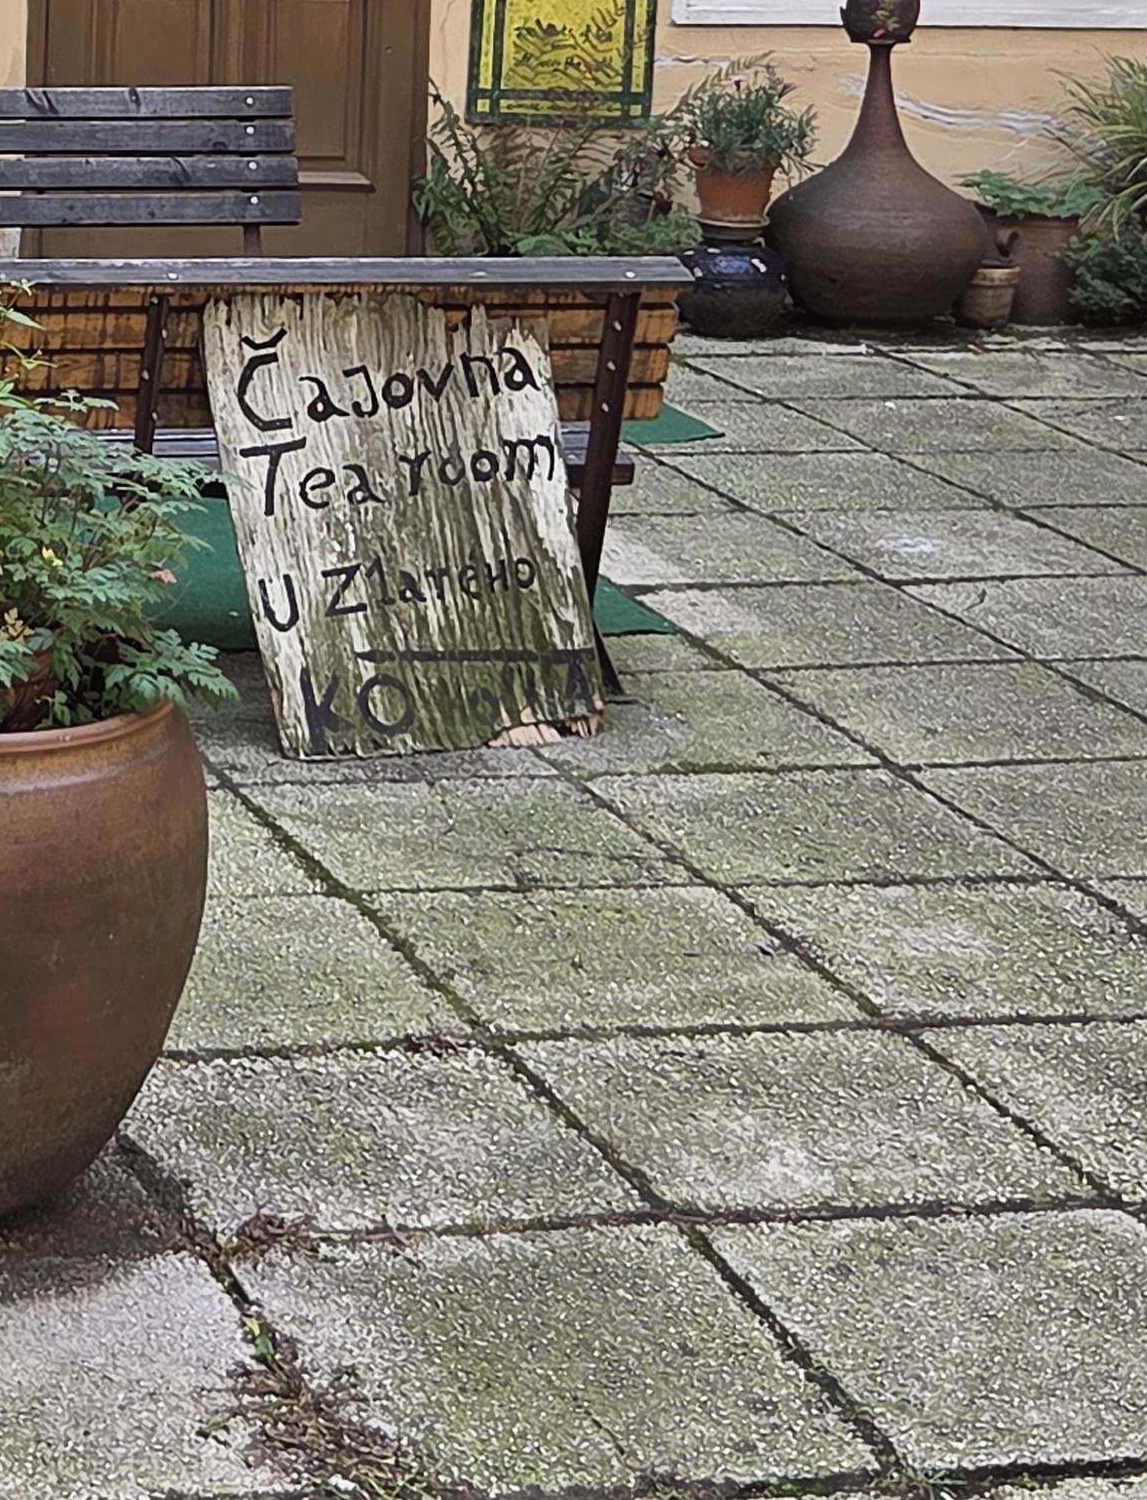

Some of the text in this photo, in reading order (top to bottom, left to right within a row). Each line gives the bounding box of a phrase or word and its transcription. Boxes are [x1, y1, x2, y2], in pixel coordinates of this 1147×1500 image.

[240, 434, 555, 517] Tea room
[258, 573, 301, 633] U
